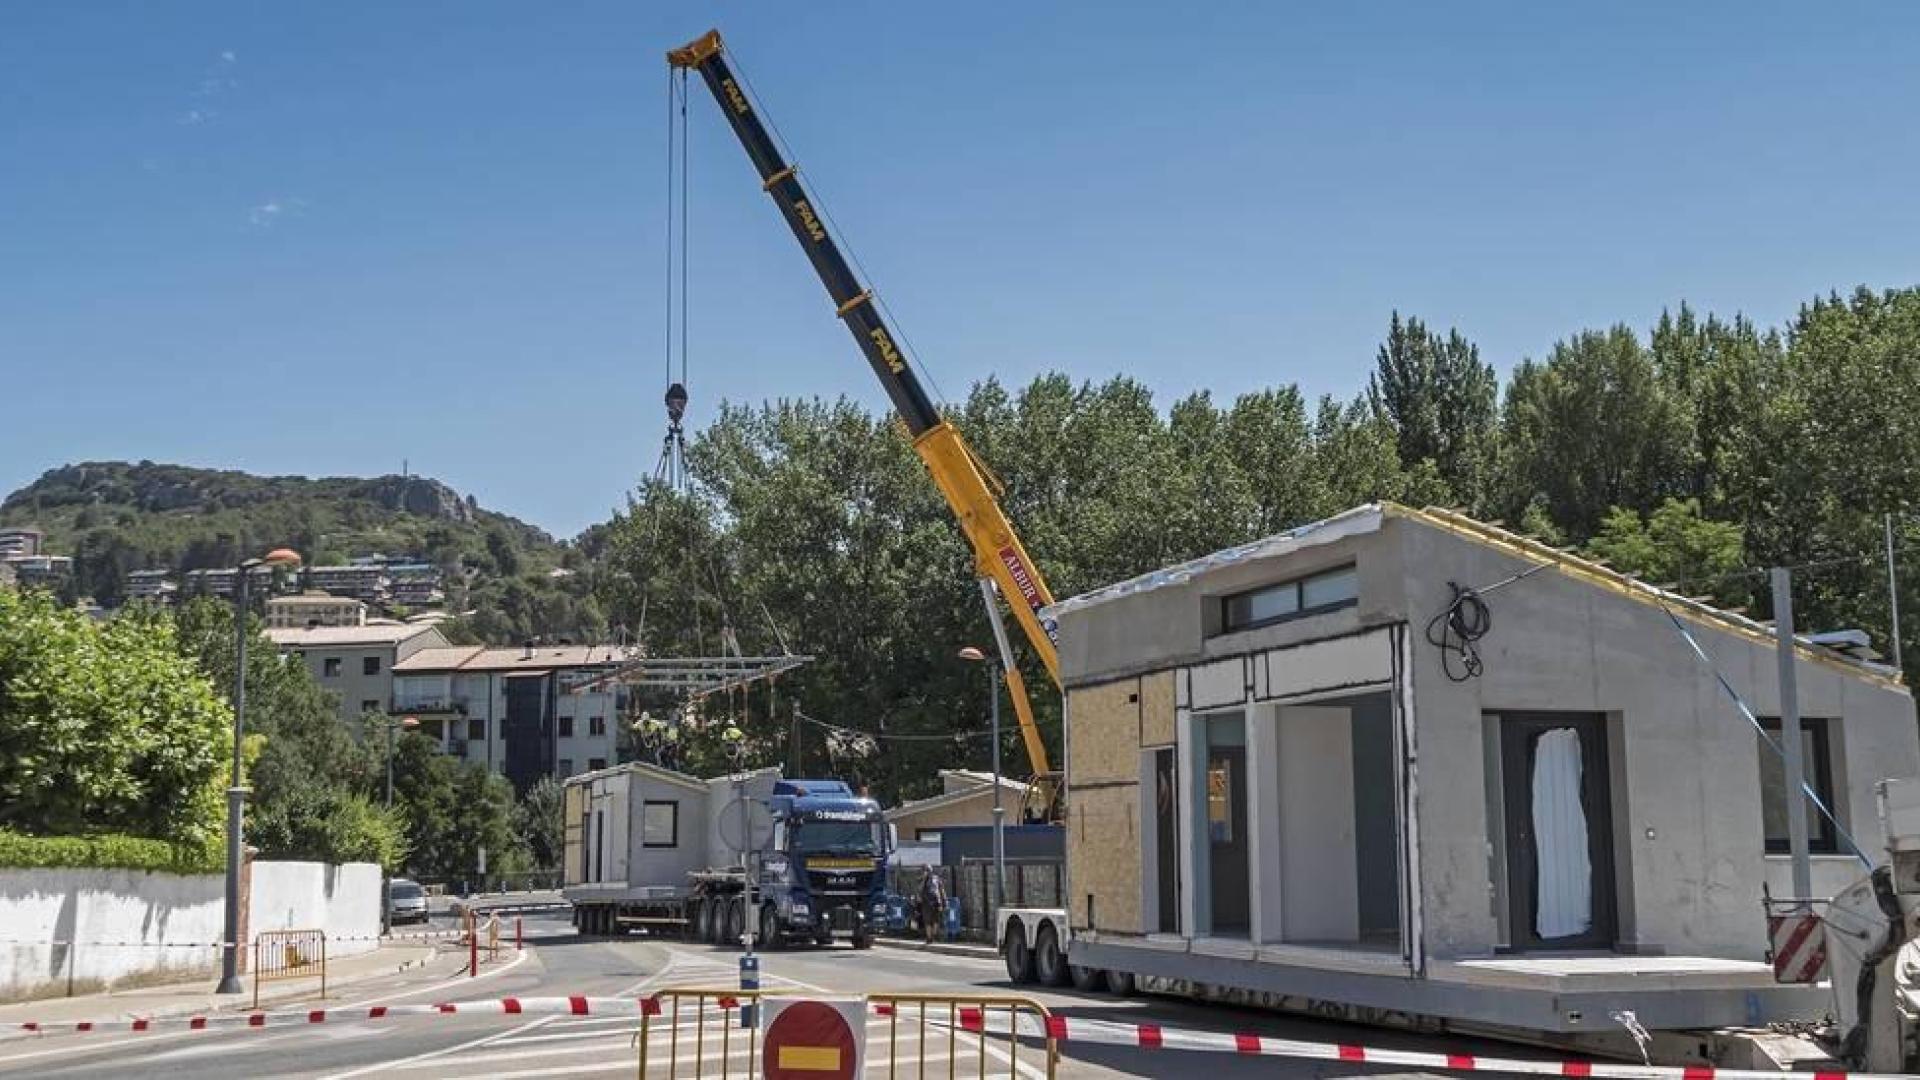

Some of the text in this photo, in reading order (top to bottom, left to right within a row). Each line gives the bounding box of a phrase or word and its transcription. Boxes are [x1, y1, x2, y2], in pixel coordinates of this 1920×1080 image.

[723, 79, 748, 114] FAM
[795, 200, 825, 241] FAM
[870, 328, 904, 374] FAM
